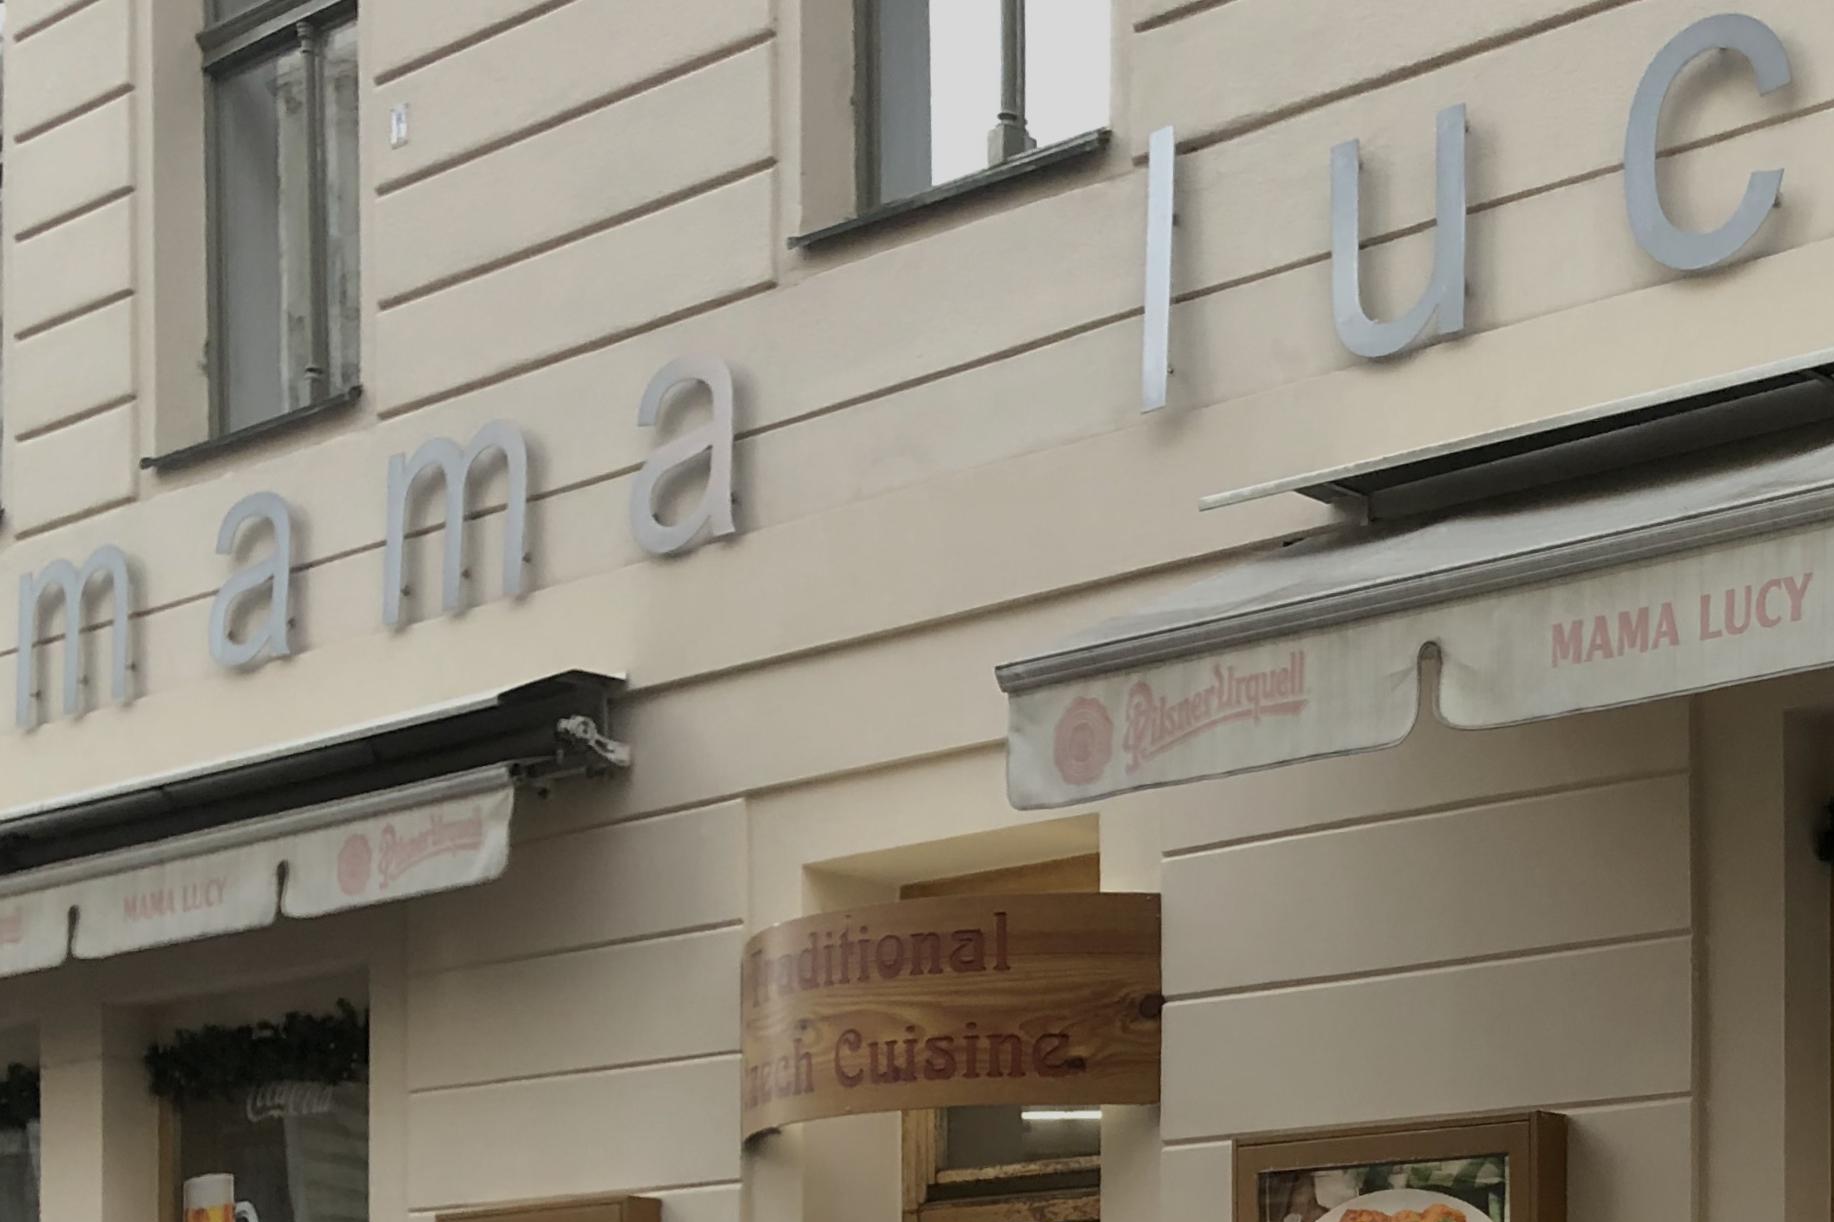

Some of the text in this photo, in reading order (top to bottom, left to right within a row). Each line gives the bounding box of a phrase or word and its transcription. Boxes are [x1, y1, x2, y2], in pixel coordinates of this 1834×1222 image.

[15, 355, 738, 732] mama
[1551, 572, 1814, 668] MAMA LUCY
[1122, 680, 1216, 776] Pilsner
[1212, 650, 1306, 725] Urquell
[834, 1022, 1078, 1088] Cuisine
